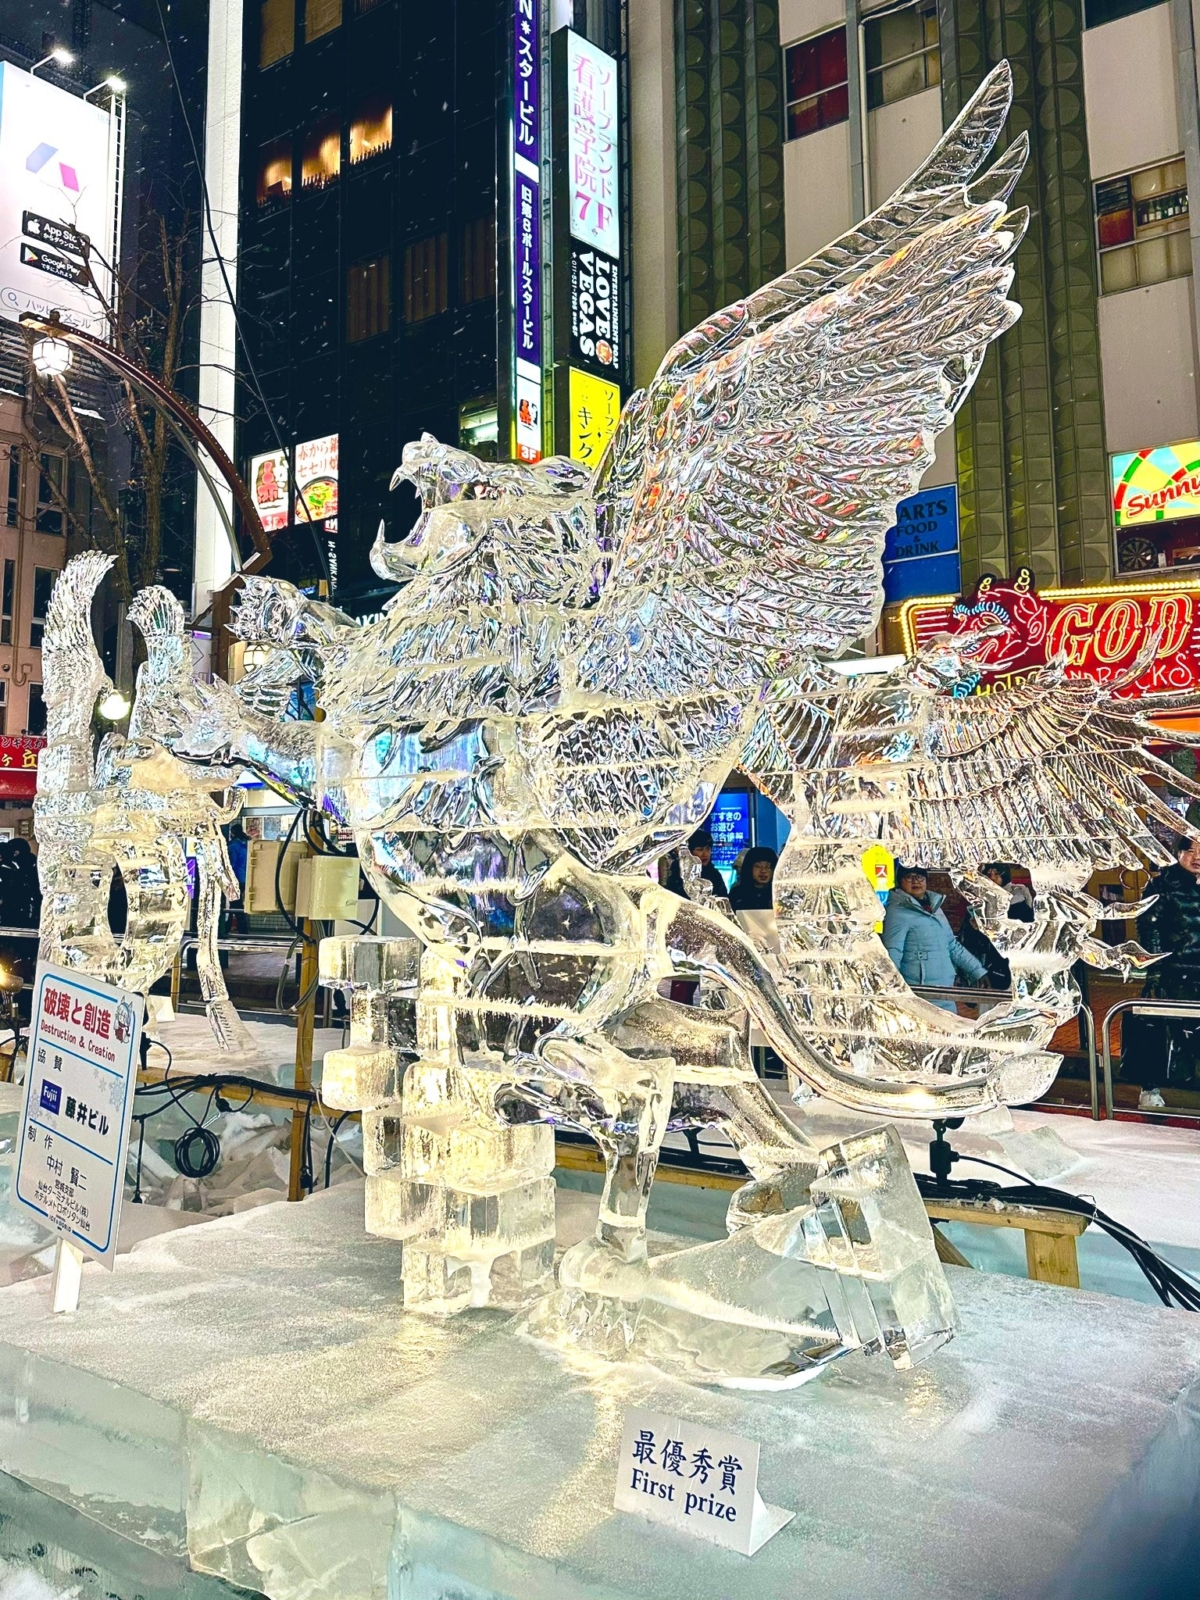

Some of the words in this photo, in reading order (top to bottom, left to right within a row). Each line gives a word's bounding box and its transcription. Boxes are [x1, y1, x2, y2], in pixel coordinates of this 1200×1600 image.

[572, 54, 597, 193] 看護学院
[598, 63, 613, 198] ソープランド
[44, 223, 62, 237] App
[575, 190, 613, 230] 7F
[43, 233, 82, 254] からダウンロー
[41, 254, 66, 271] Google
[66, 262, 81, 277] Play
[579, 251, 595, 357] VEGAS
[595, 256, 611, 339] LOVE
[521, 446, 537, 461] 3F
[896, 520, 938, 538] FOOD
[896, 540, 940, 558] DRINK
[913, 535, 921, 543] &
[1045, 593, 1193, 667] GOD
[711, 811, 742, 821] すすきの
[711, 822, 735, 832] お遊び
[43, 987, 111, 1040] 破壊と創造
[40, 1019, 77, 1045] Destruction
[79, 1035, 85, 1049] &
[88, 1039, 116, 1063] Creation
[65, 1096, 109, 1136] 藤井ビル
[632, 1429, 743, 1496] 最優秀賞
[630, 1467, 676, 1502] First
[684, 1491, 738, 1522] prize
